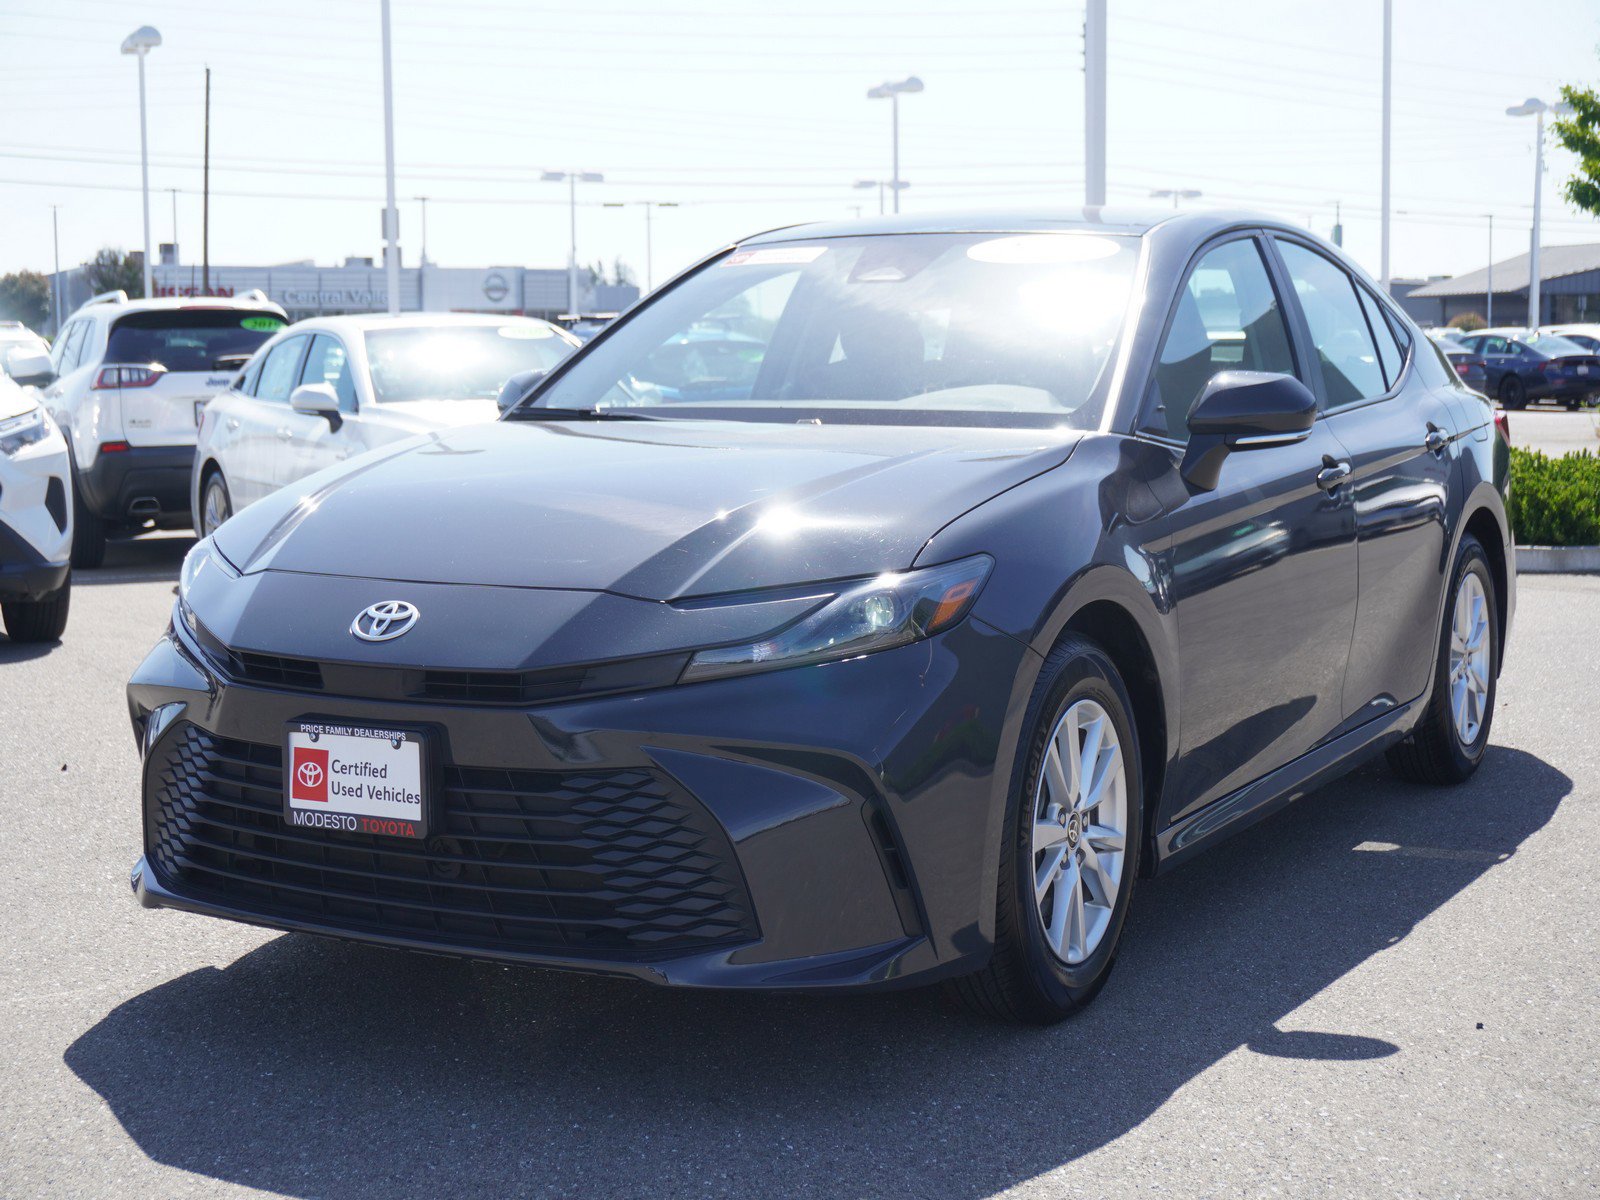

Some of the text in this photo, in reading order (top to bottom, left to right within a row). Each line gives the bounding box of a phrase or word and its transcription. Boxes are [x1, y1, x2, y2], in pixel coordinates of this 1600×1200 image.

[349, 290, 389, 305] Valle
[300, 724, 407, 741] PRICE FAMILY DEALERSHIPS
[331, 759, 388, 779] Certified
[331, 781, 421, 805] Used Vehicles
[293, 811, 415, 837] MODESTO TOYOTA
